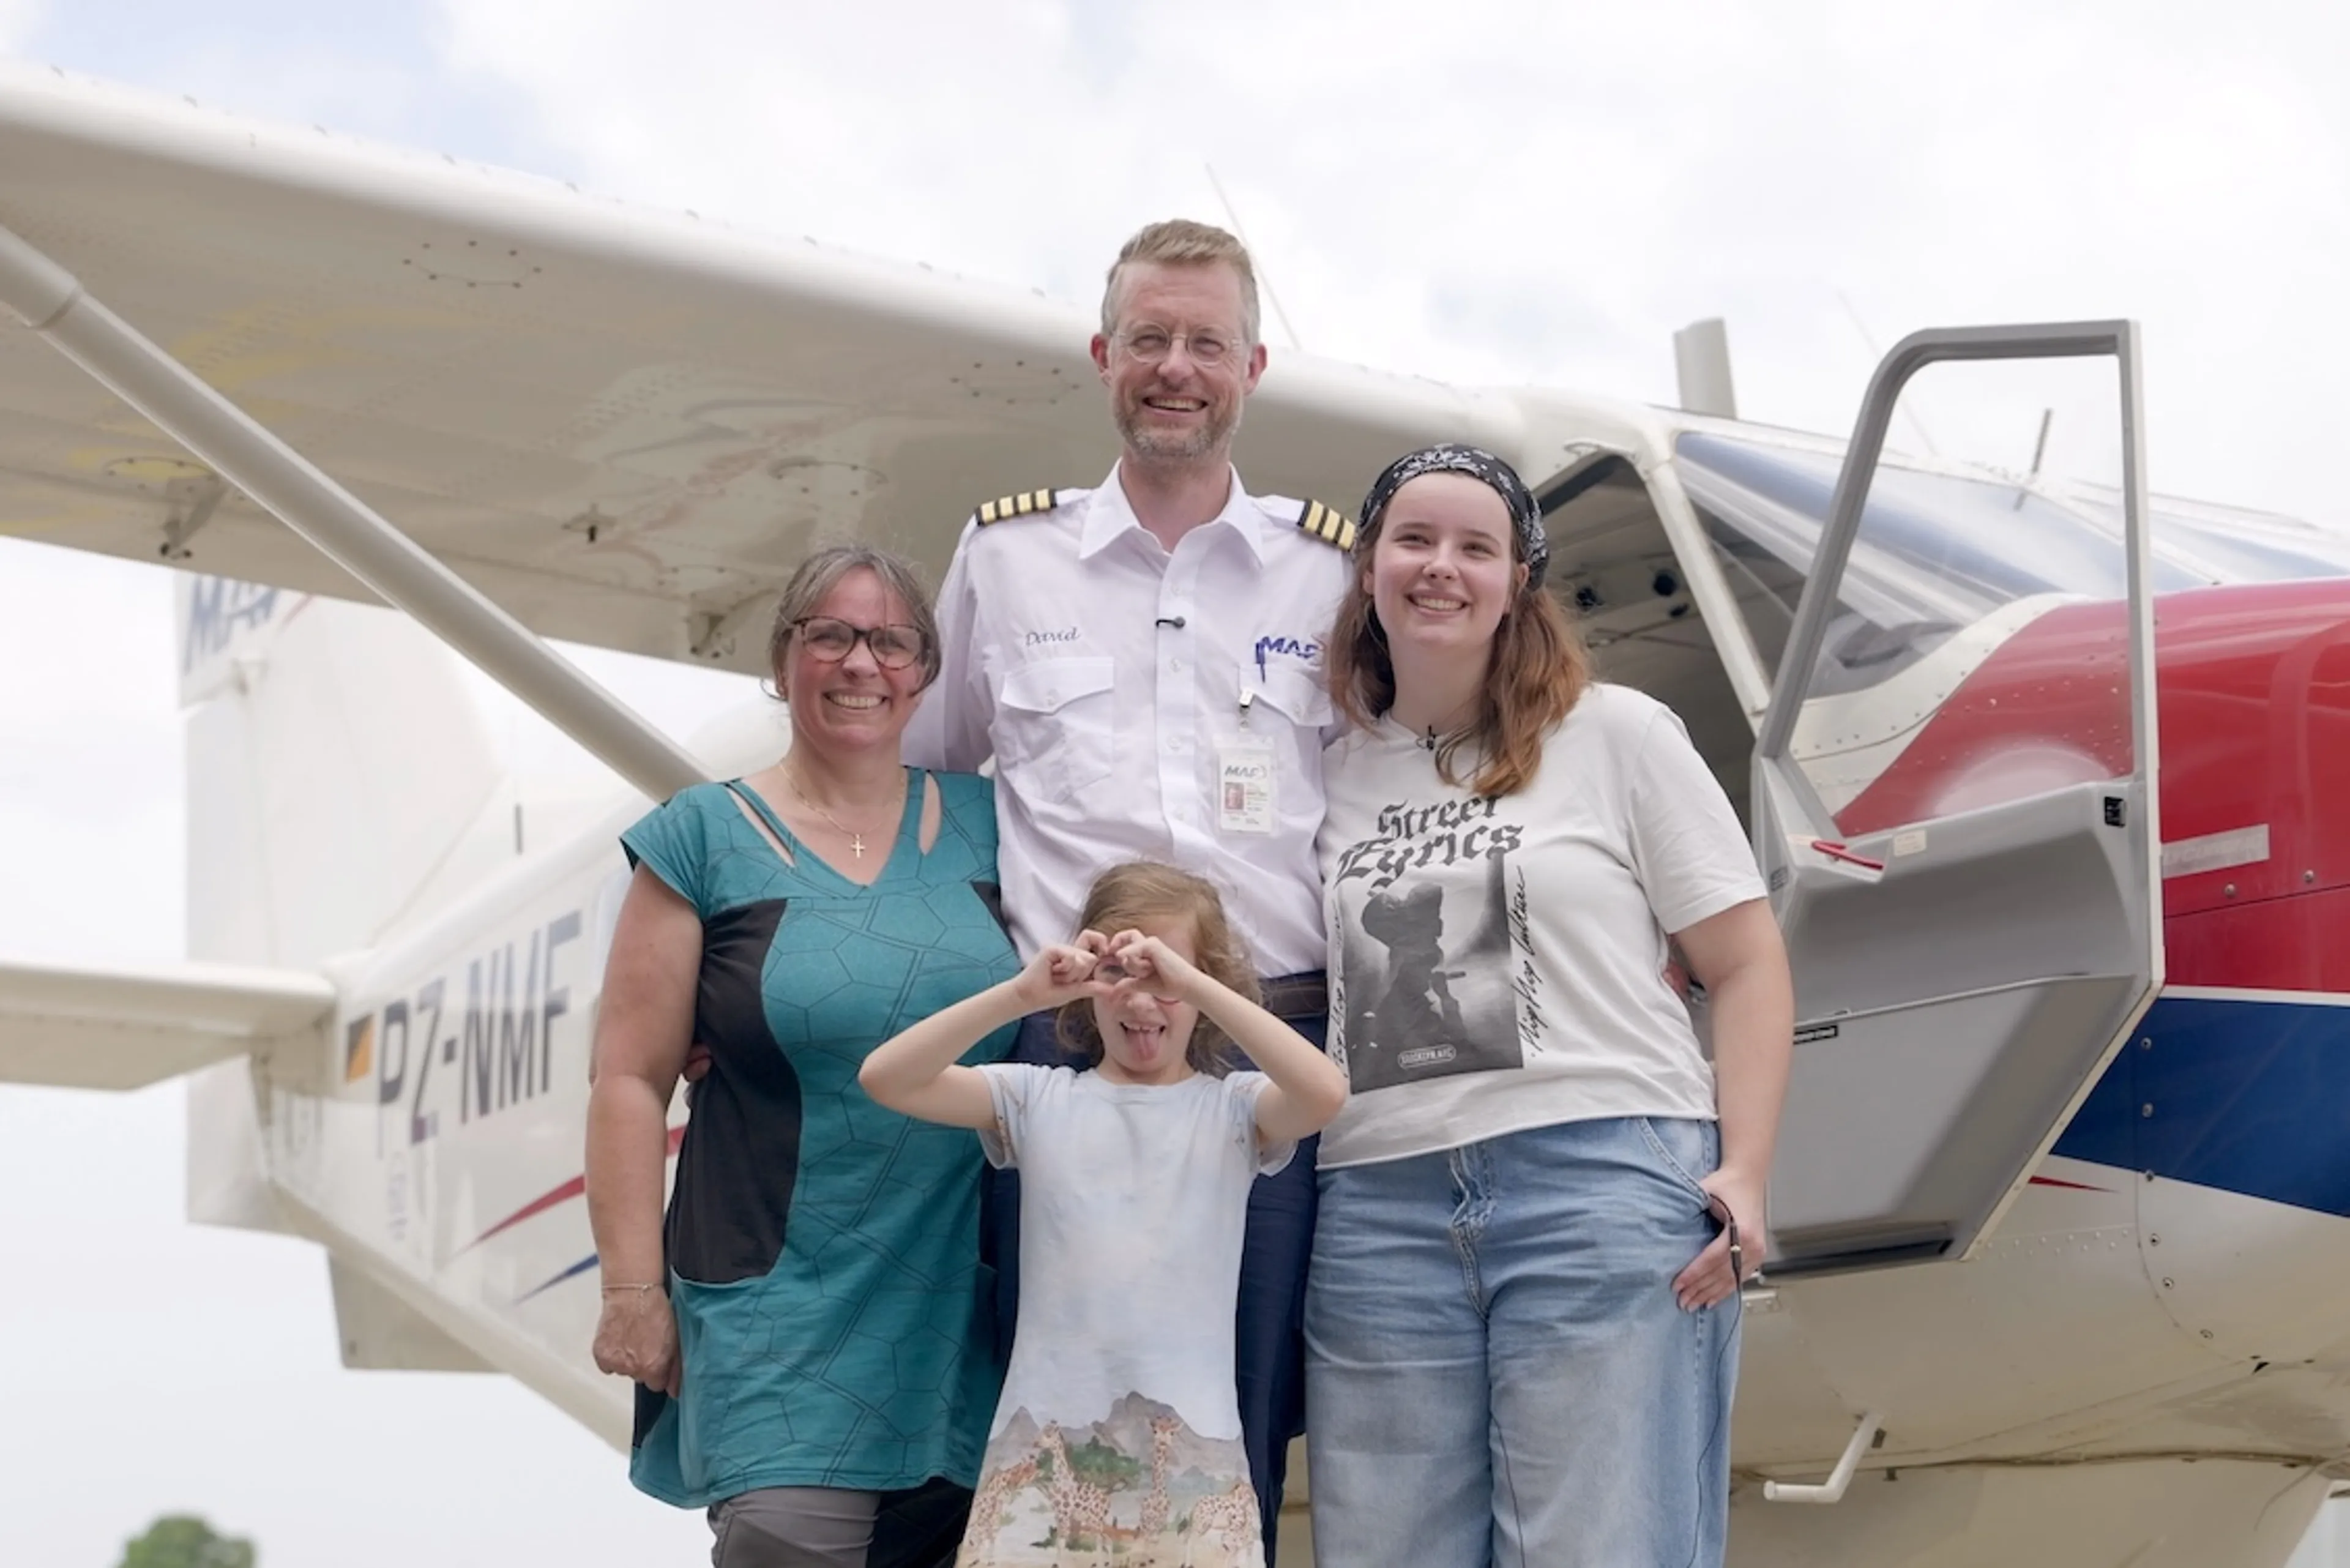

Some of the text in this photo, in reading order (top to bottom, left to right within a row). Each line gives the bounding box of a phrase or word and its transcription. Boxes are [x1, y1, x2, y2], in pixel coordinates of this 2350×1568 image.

[1025, 627, 1082, 646] David
[1378, 796, 1500, 839] Street
[1334, 826, 1524, 889] Lyrics
[379, 909, 581, 1145] PZ-NMF
